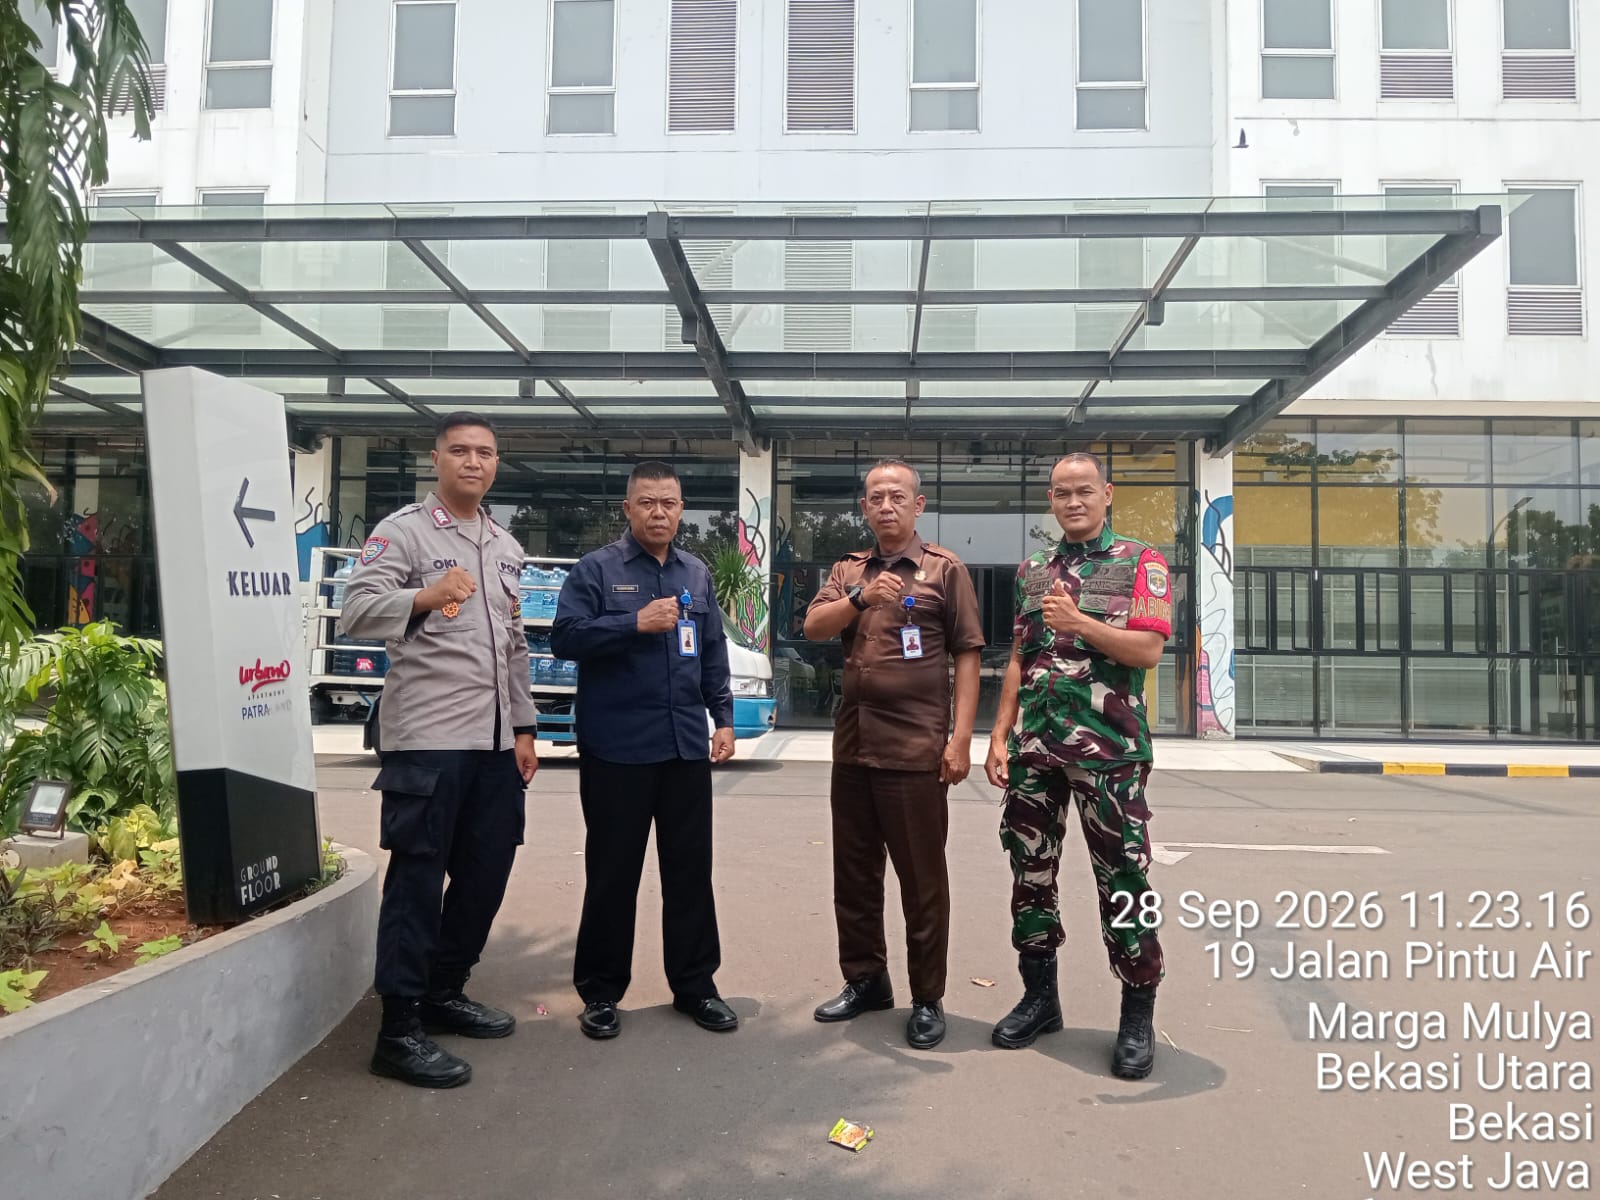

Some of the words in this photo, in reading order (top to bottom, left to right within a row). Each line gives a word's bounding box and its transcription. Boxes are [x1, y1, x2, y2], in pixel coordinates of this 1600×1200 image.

[228, 570, 291, 597] KELUAR
[240, 855, 279, 882] GROUND
[240, 871, 281, 906] FLOOR
